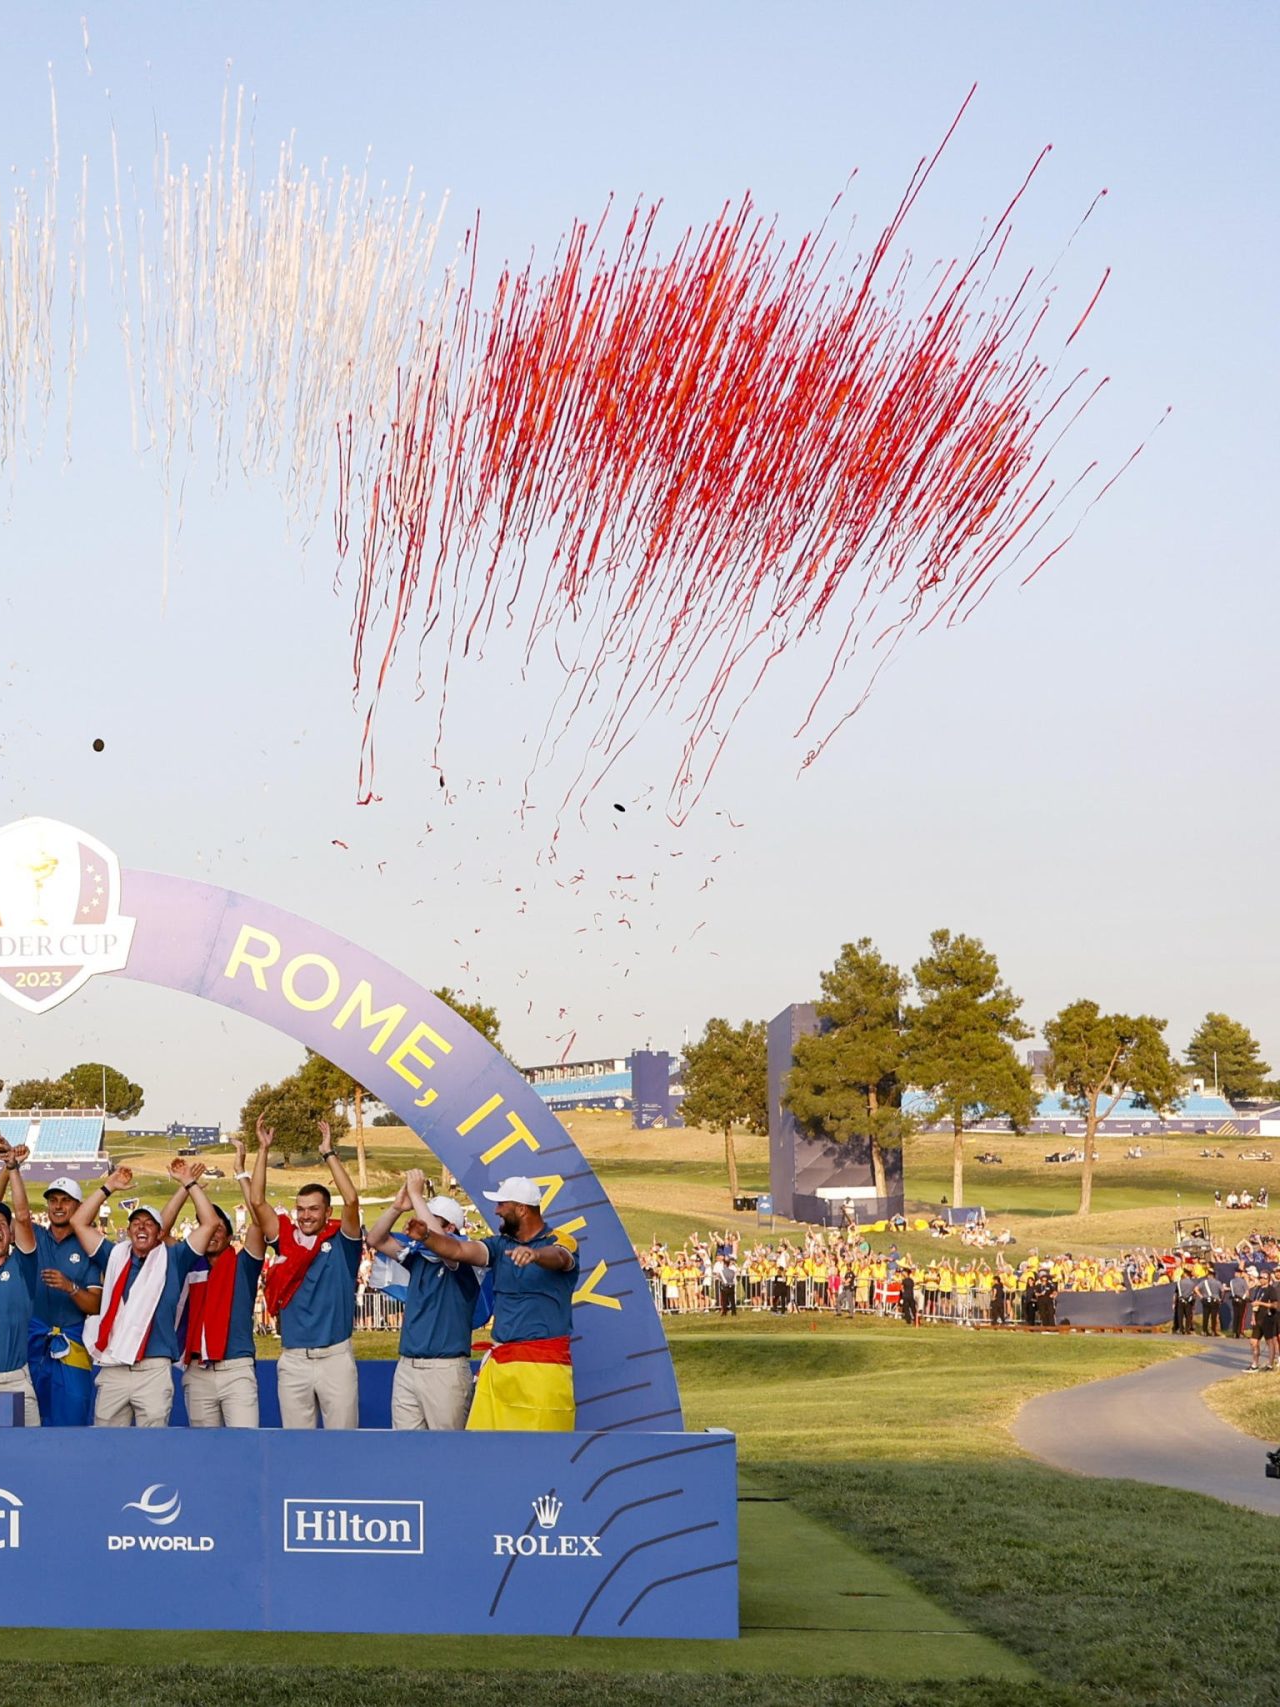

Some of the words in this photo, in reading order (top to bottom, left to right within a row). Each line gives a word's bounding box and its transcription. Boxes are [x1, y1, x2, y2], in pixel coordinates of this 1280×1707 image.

[60, 934, 118, 956] CUP
[15, 971, 63, 988] 2023
[224, 924, 454, 1108] ROME,
[295, 1510, 412, 1543] Hilton
[107, 1535, 136, 1551] DP
[138, 1535, 215, 1552] WORLD
[493, 1534, 603, 1557] ROLEX
